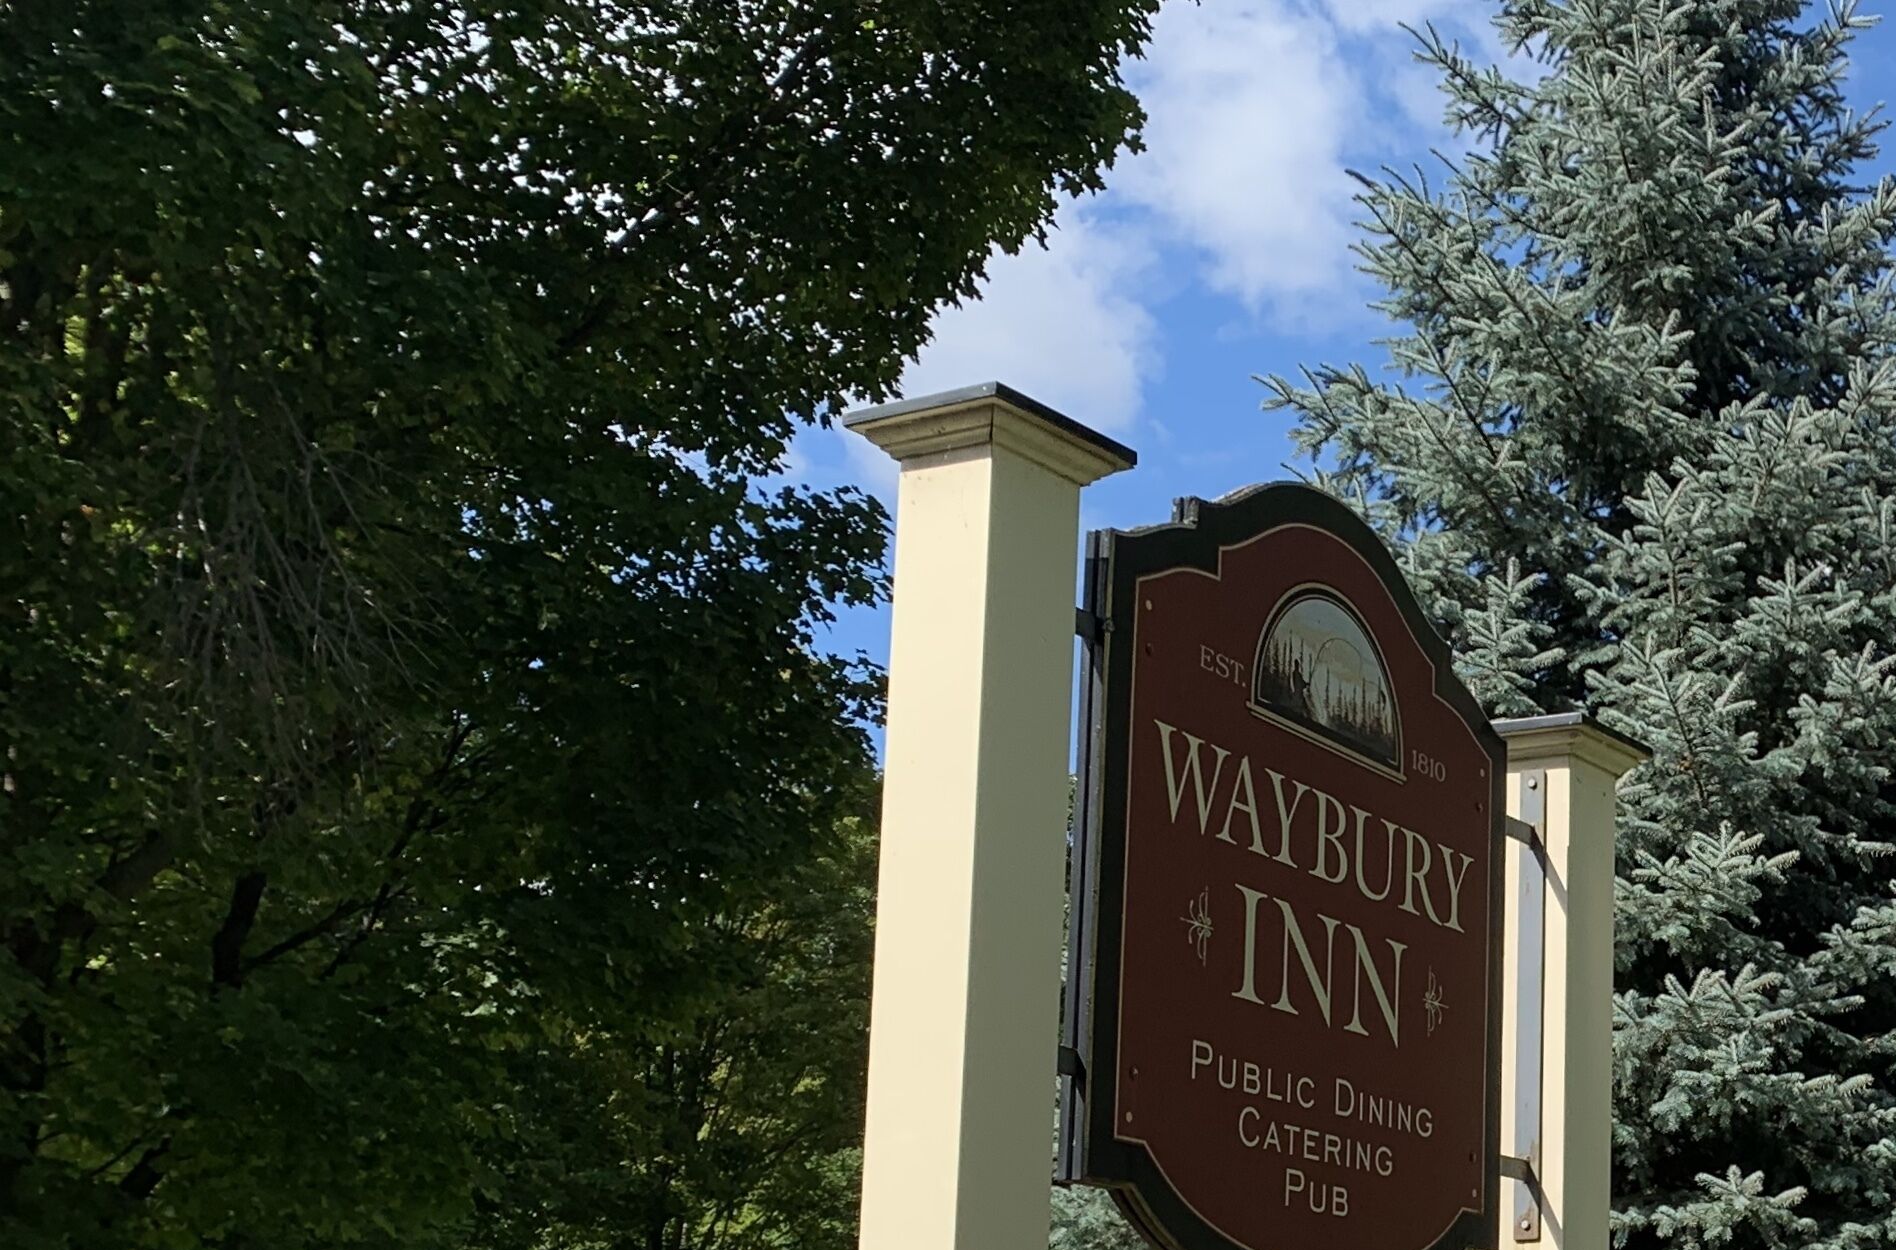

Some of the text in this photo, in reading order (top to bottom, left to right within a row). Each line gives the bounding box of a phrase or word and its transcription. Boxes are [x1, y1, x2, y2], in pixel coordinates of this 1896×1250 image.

[1199, 645, 1246, 688] EST.
[1411, 749, 1446, 783] 1810
[1154, 719, 1475, 933] WAYBURY
[1231, 883, 1408, 1048] INN
[1191, 1039, 1433, 1138] PUBLIC DINING
[1238, 1106, 1393, 1177] CATERING
[1284, 1168, 1349, 1217] PUB
